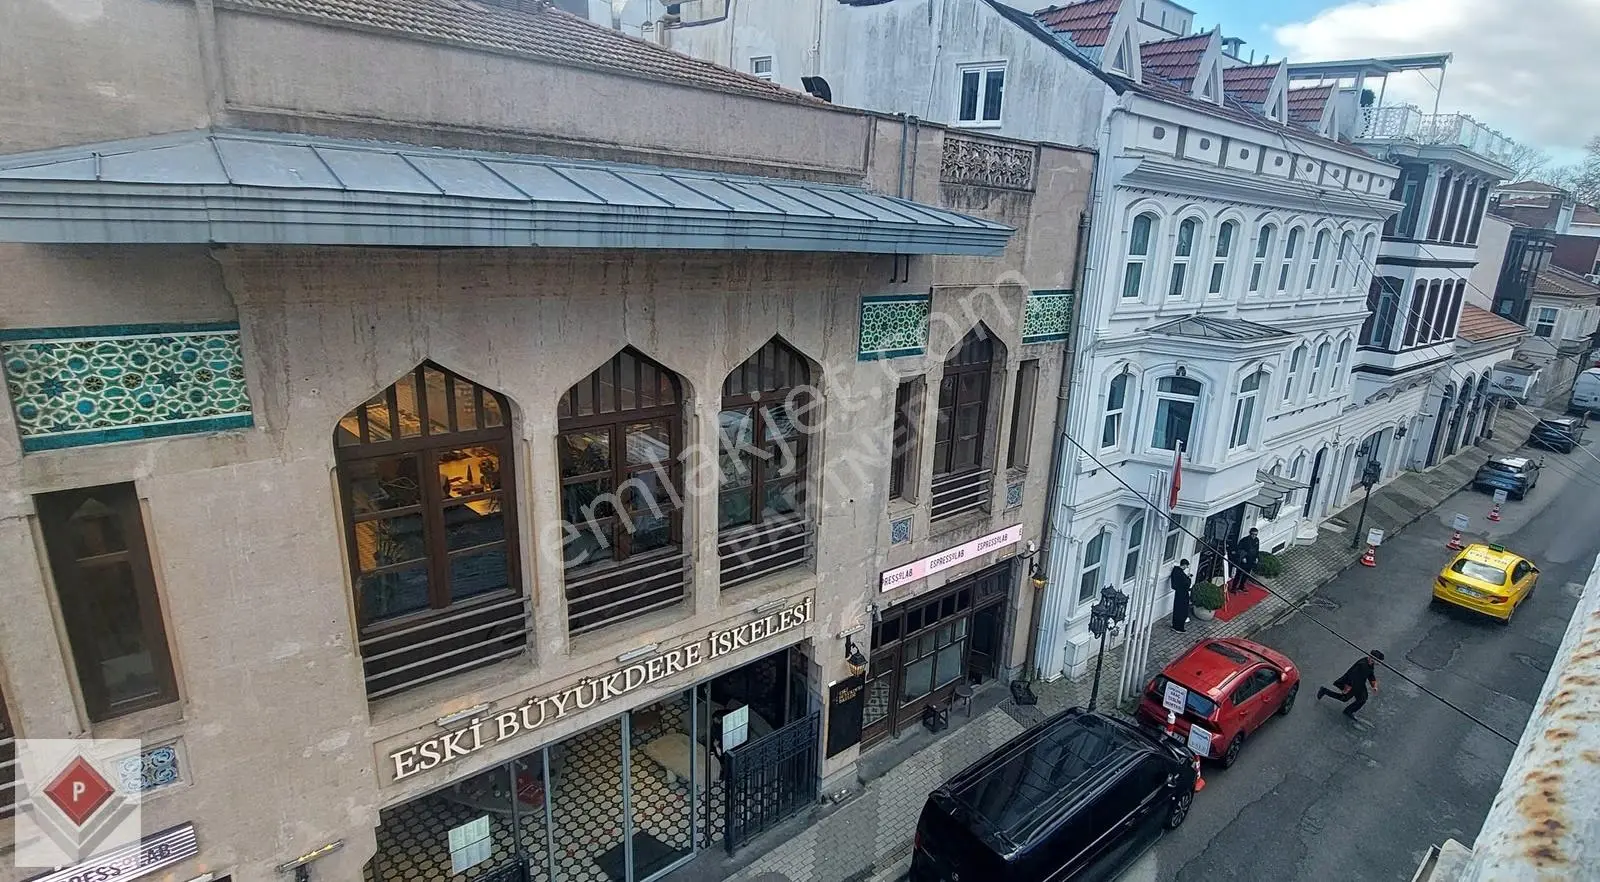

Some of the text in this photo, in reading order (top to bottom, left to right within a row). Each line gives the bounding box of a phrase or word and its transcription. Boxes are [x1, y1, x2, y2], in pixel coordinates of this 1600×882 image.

[389, 718, 485, 781] ESKİ
[494, 641, 702, 742] BÜYÜKDERE
[708, 597, 813, 659] İSKELESİ
